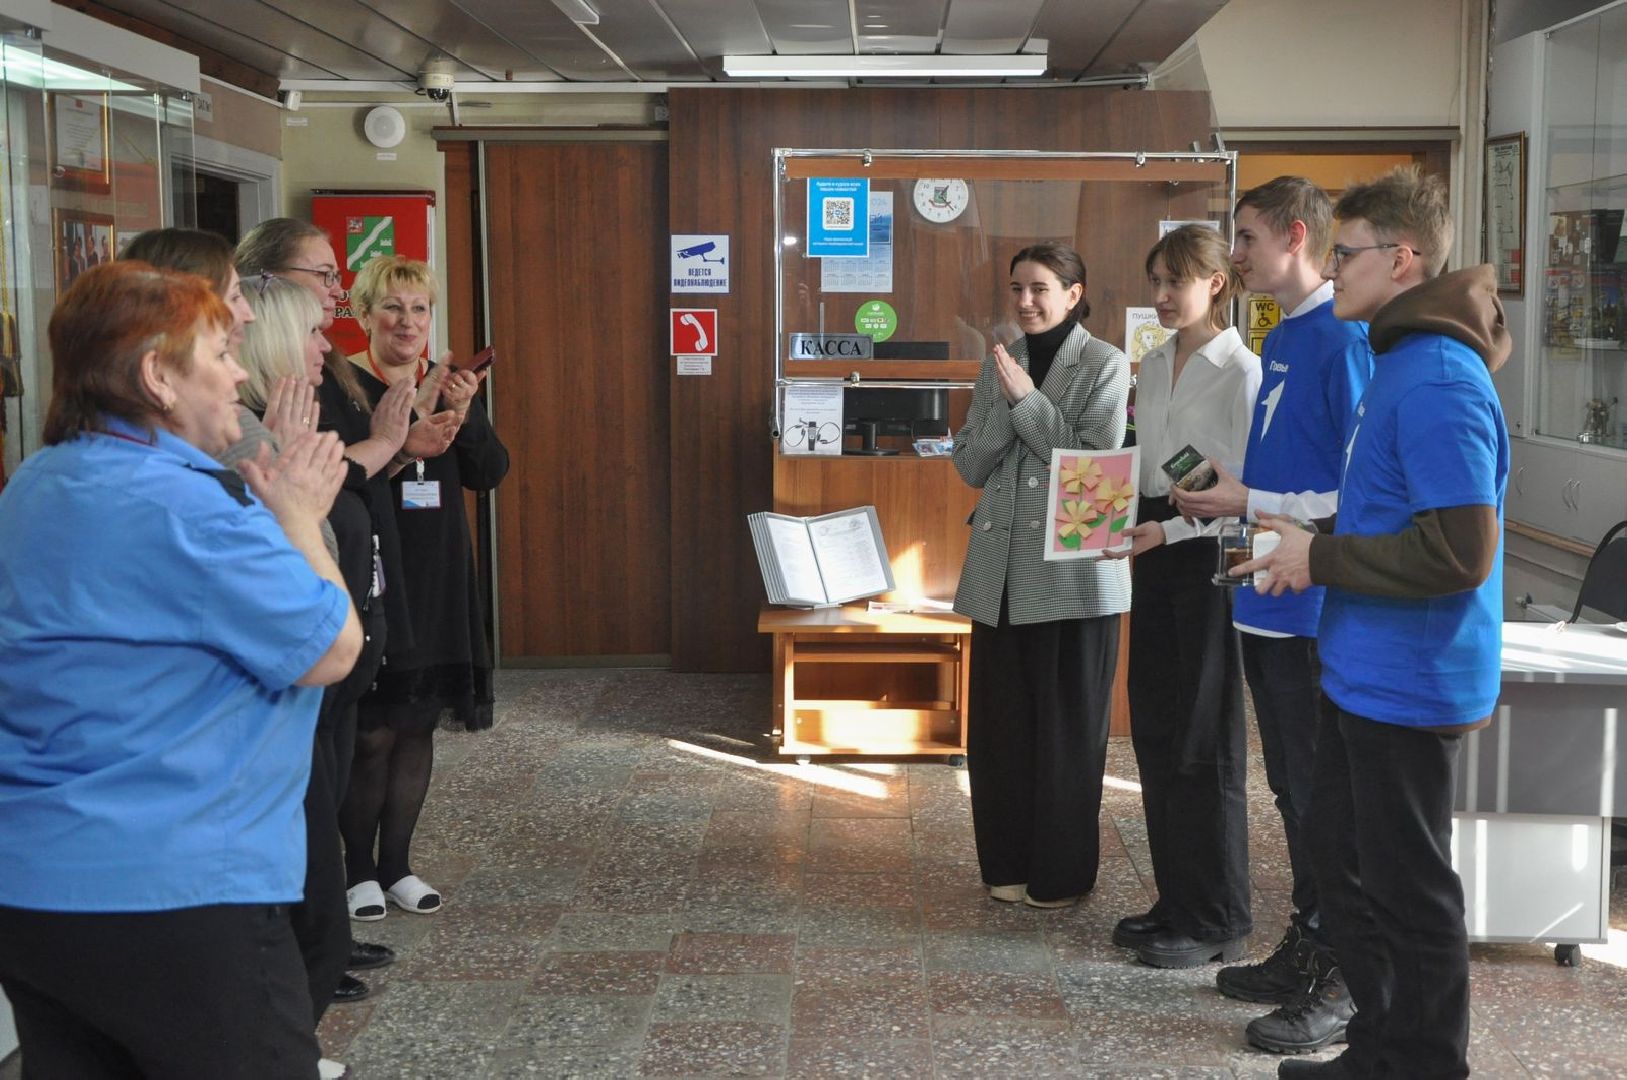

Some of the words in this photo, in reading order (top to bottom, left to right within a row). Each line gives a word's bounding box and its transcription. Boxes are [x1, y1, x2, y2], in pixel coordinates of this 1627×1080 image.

[688, 268, 712, 277] ВЕДЕТСЯ
[673, 279, 727, 288] ВИДЕОНАБЛЮДЕНИЕ
[1255, 302, 1275, 311] WC
[800, 339, 863, 356] КАССА
